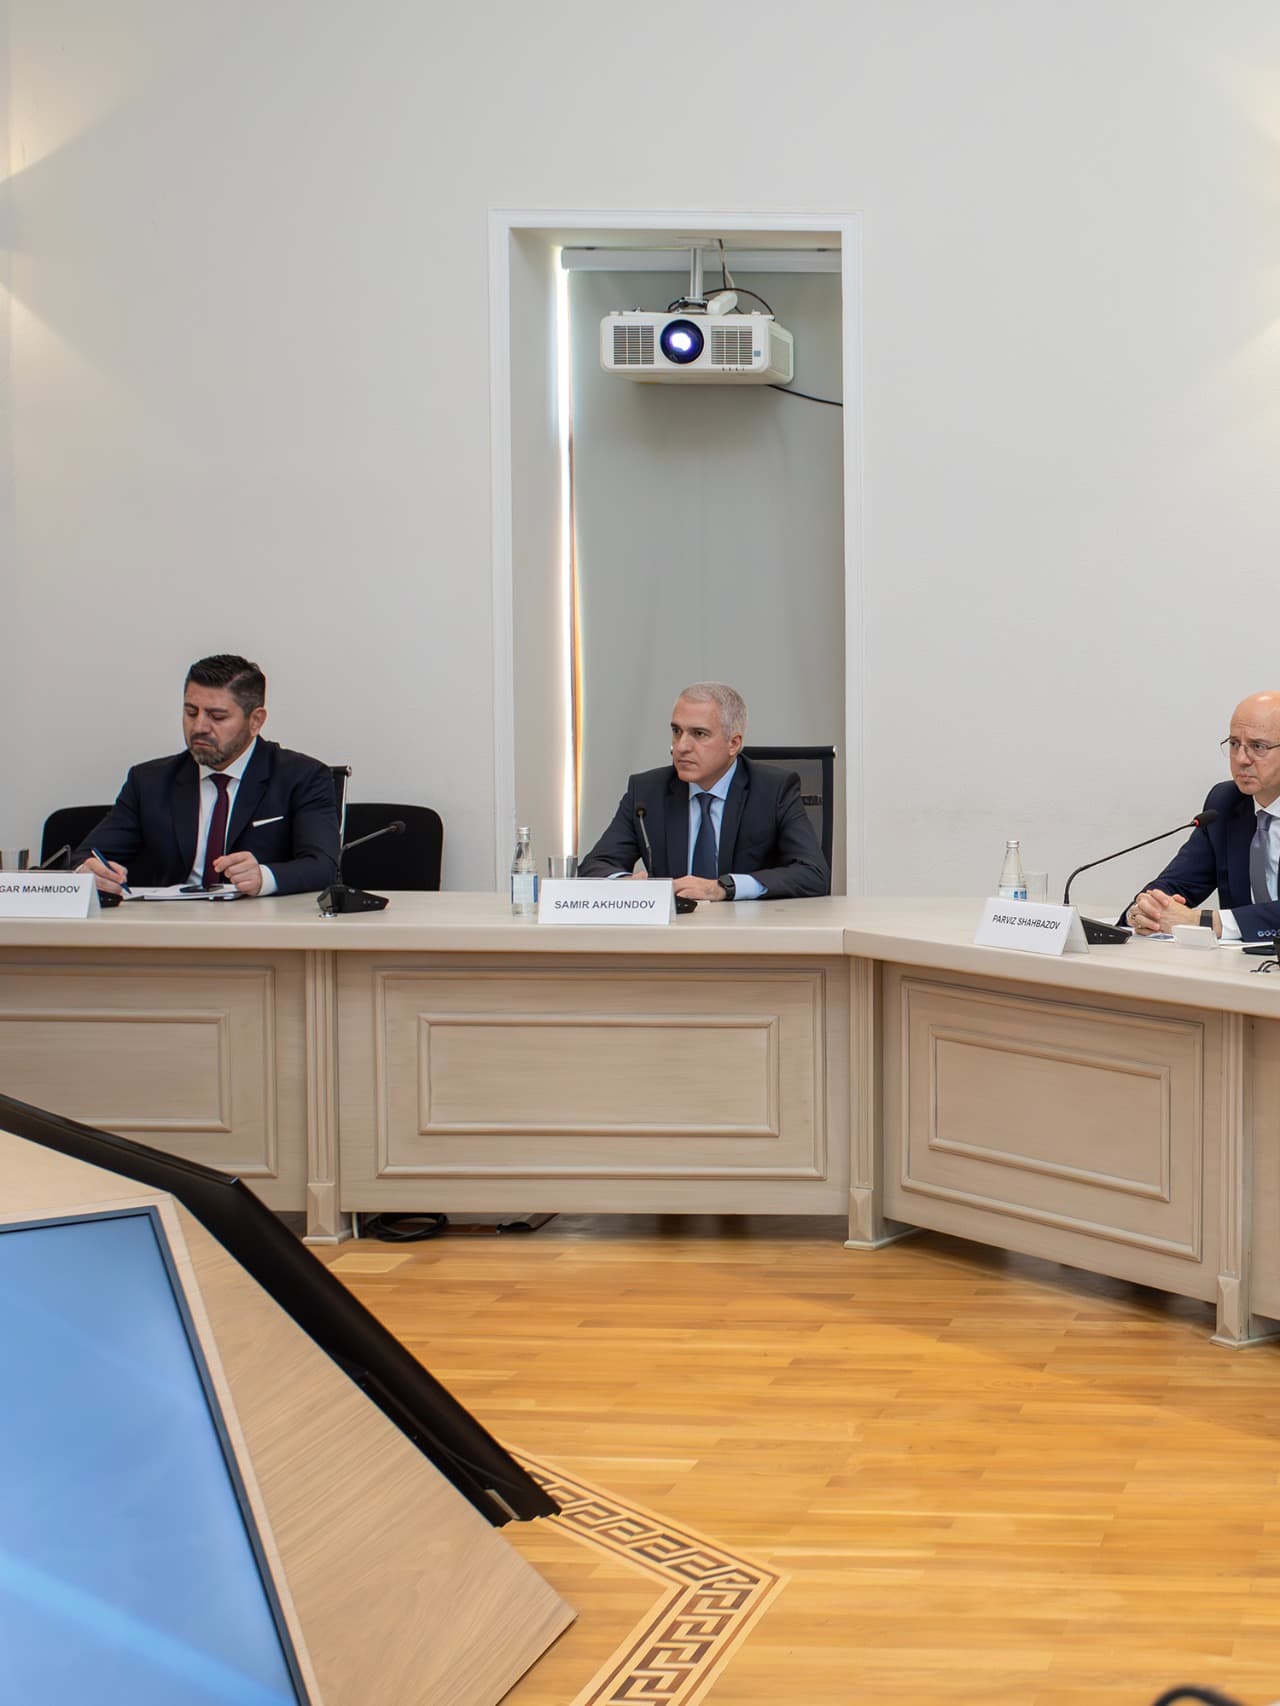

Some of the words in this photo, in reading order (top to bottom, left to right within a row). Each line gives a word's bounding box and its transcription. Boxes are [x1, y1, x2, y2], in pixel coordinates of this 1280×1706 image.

[22, 885, 80, 893] MAHMUDOV
[554, 900, 590, 909] SAMIR
[592, 900, 655, 909] AKHUNDOV
[992, 914, 1017, 925] PARVIZ
[1017, 917, 1061, 930] SHAHBAZOV
